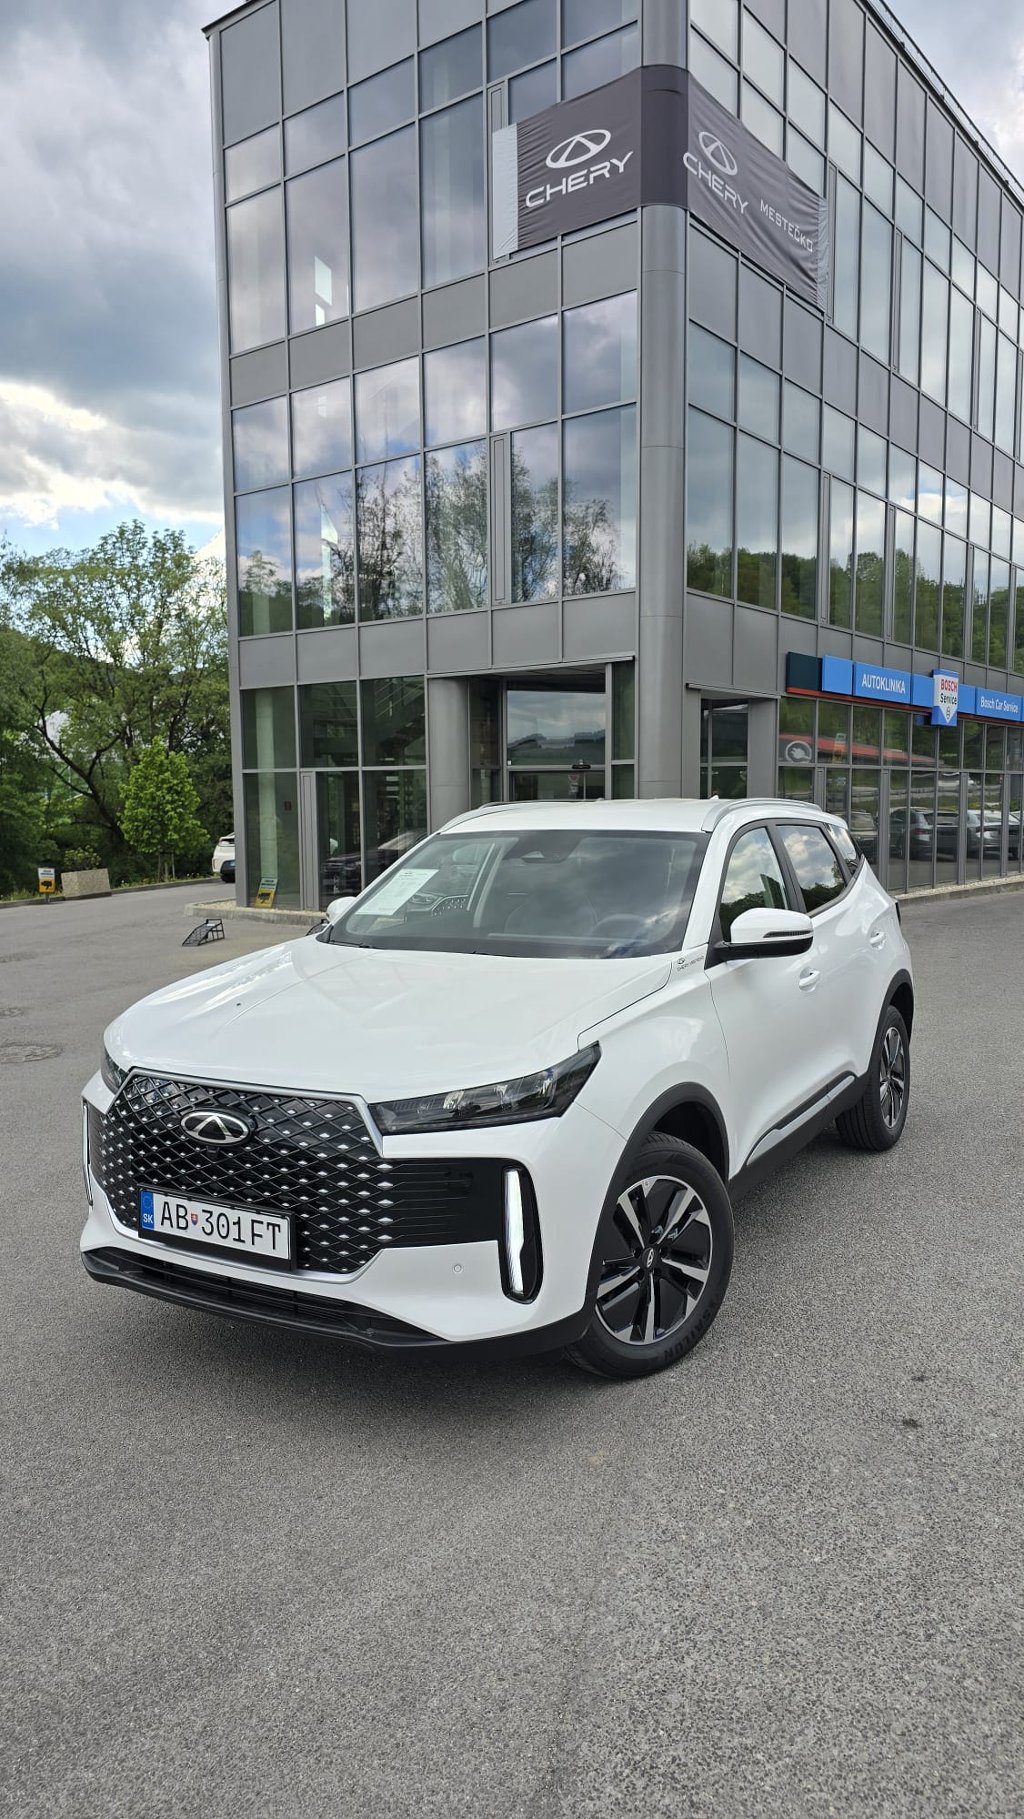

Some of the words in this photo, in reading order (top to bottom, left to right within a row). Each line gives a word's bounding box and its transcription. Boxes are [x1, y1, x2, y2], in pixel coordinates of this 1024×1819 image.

[526, 151, 633, 208] CHERY
[682, 151, 749, 214] CHERY
[759, 199, 813, 253] MESTEČKO
[862, 674, 906, 695] AUTOKLINIKA
[941, 679, 958, 692] BOSCH
[940, 693, 958, 706] Service
[980, 696, 995, 710] Bosch
[995, 698, 1003, 711] Car
[1003, 700, 1019, 713] Service
[143, 1213, 153, 1224] SK
[161, 1201, 189, 1231] AB
[201, 1209, 281, 1250] 301FT
